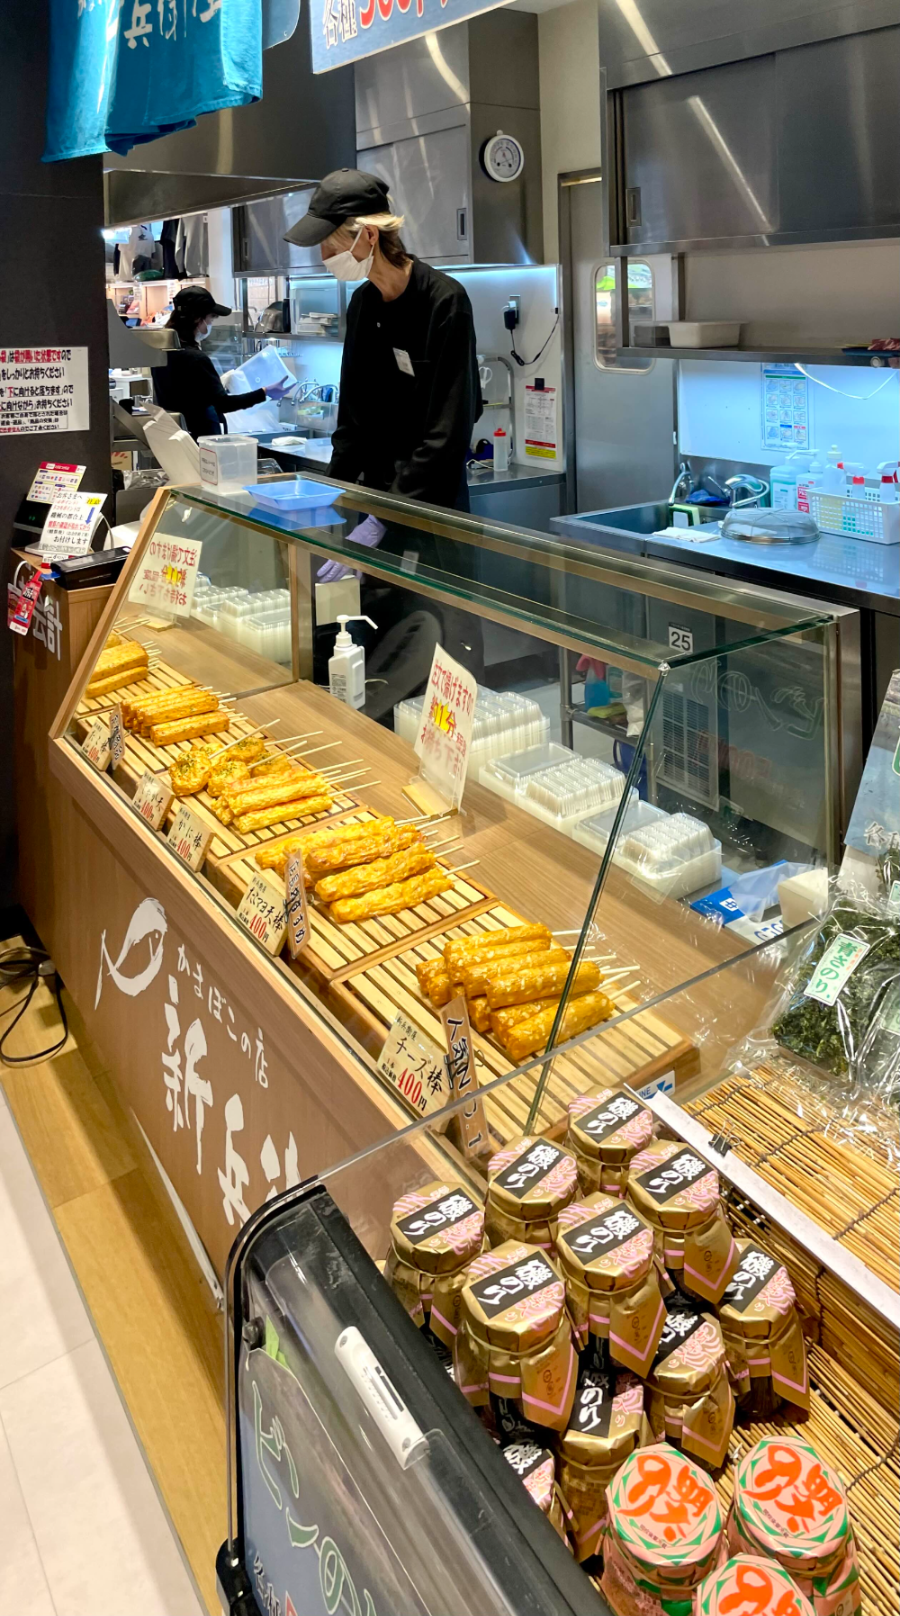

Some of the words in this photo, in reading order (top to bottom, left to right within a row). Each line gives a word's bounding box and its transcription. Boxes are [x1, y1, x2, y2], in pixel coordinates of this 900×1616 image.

[671, 631, 691, 651] 25
[248, 912, 270, 944] 400円
[176, 943, 269, 1089] かまぼこの店
[395, 1036, 443, 1097] チーズ棒
[397, 1067, 428, 1112] 400円
[583, 1096, 639, 1134] 磯のり
[503, 1144, 560, 1189] 磯のり
[645, 1153, 706, 1194] 磯のり
[403, 1194, 474, 1236] 磯のり
[570, 1210, 640, 1254] 磯のり
[477, 1258, 553, 1306] 磯のり
